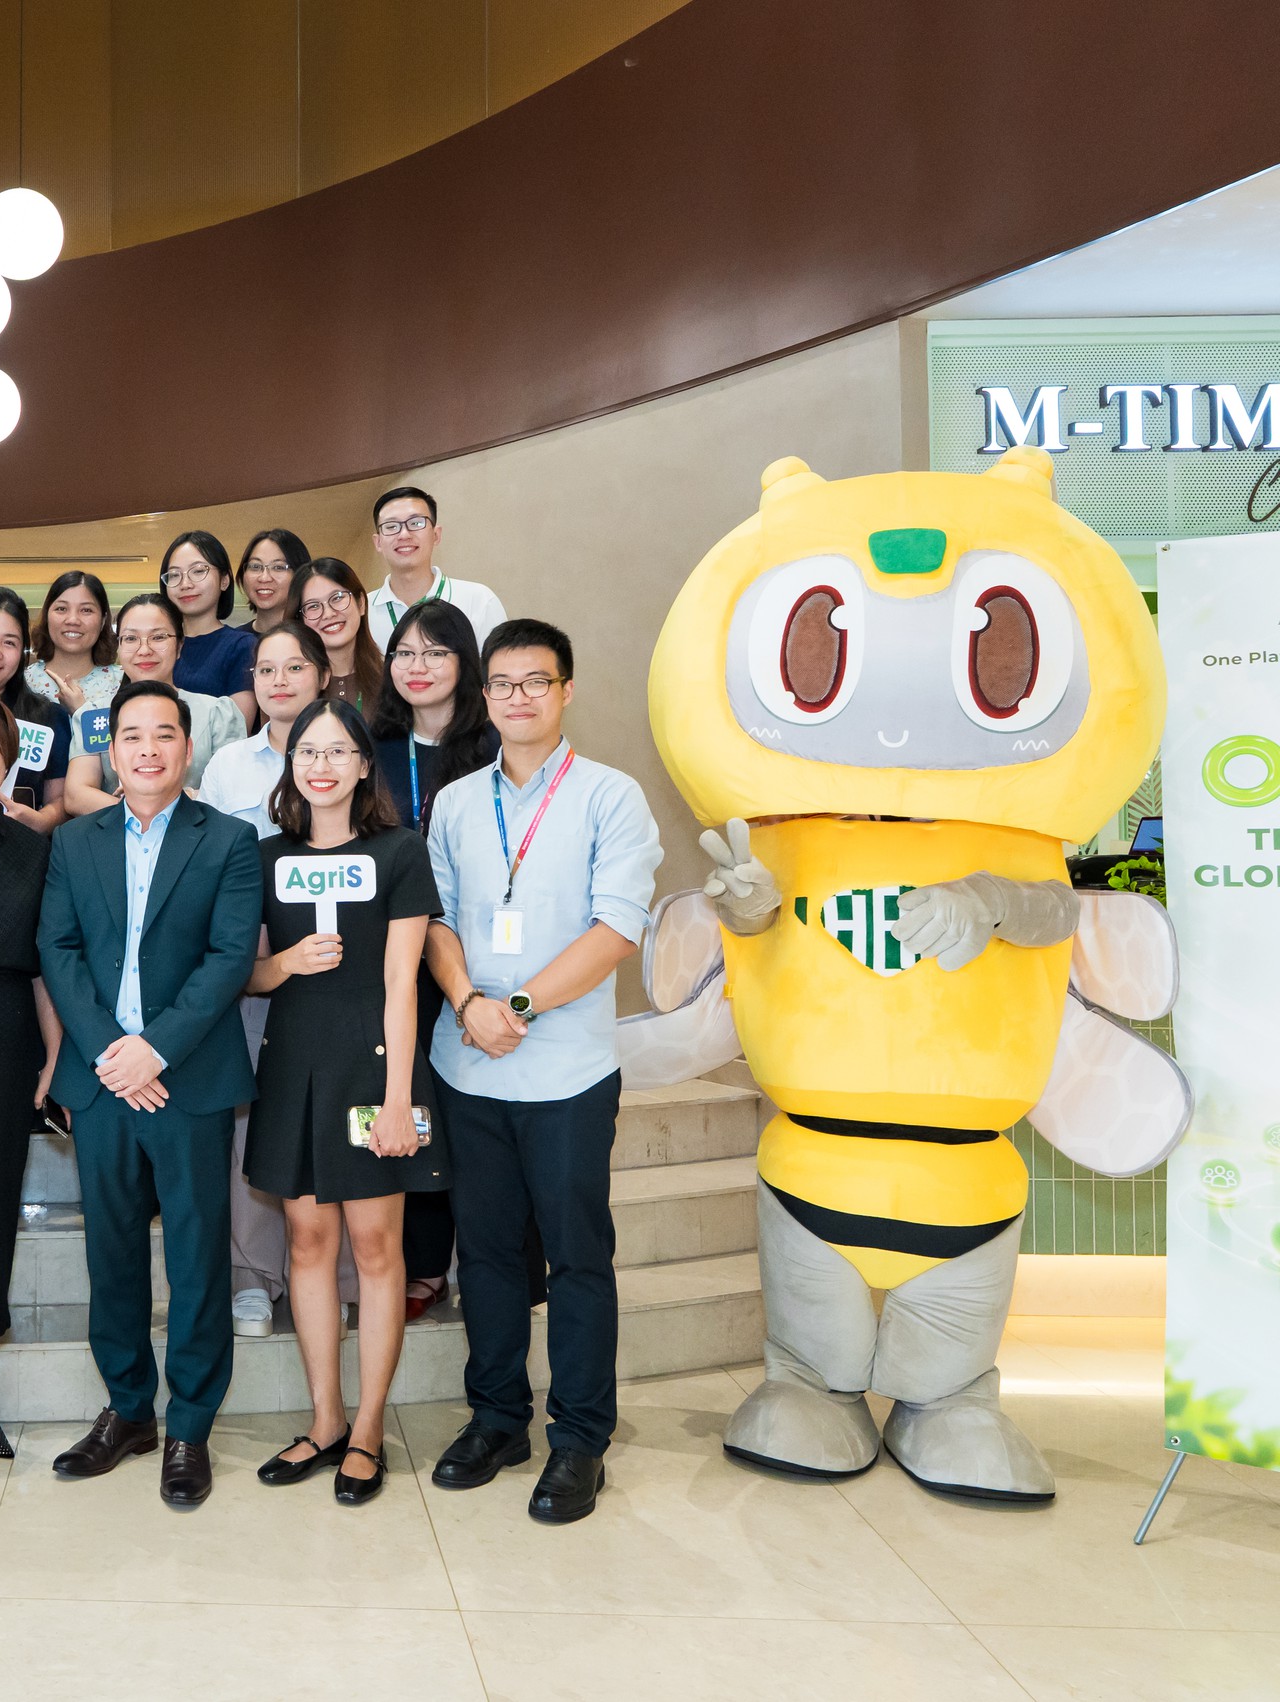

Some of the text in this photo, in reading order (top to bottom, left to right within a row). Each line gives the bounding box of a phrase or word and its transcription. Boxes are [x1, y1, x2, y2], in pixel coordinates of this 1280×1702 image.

[1202, 655, 1242, 667] One
[18, 726, 47, 746] NE
[285, 865, 362, 896] AgriS
[1194, 864, 1280, 887] GLO
